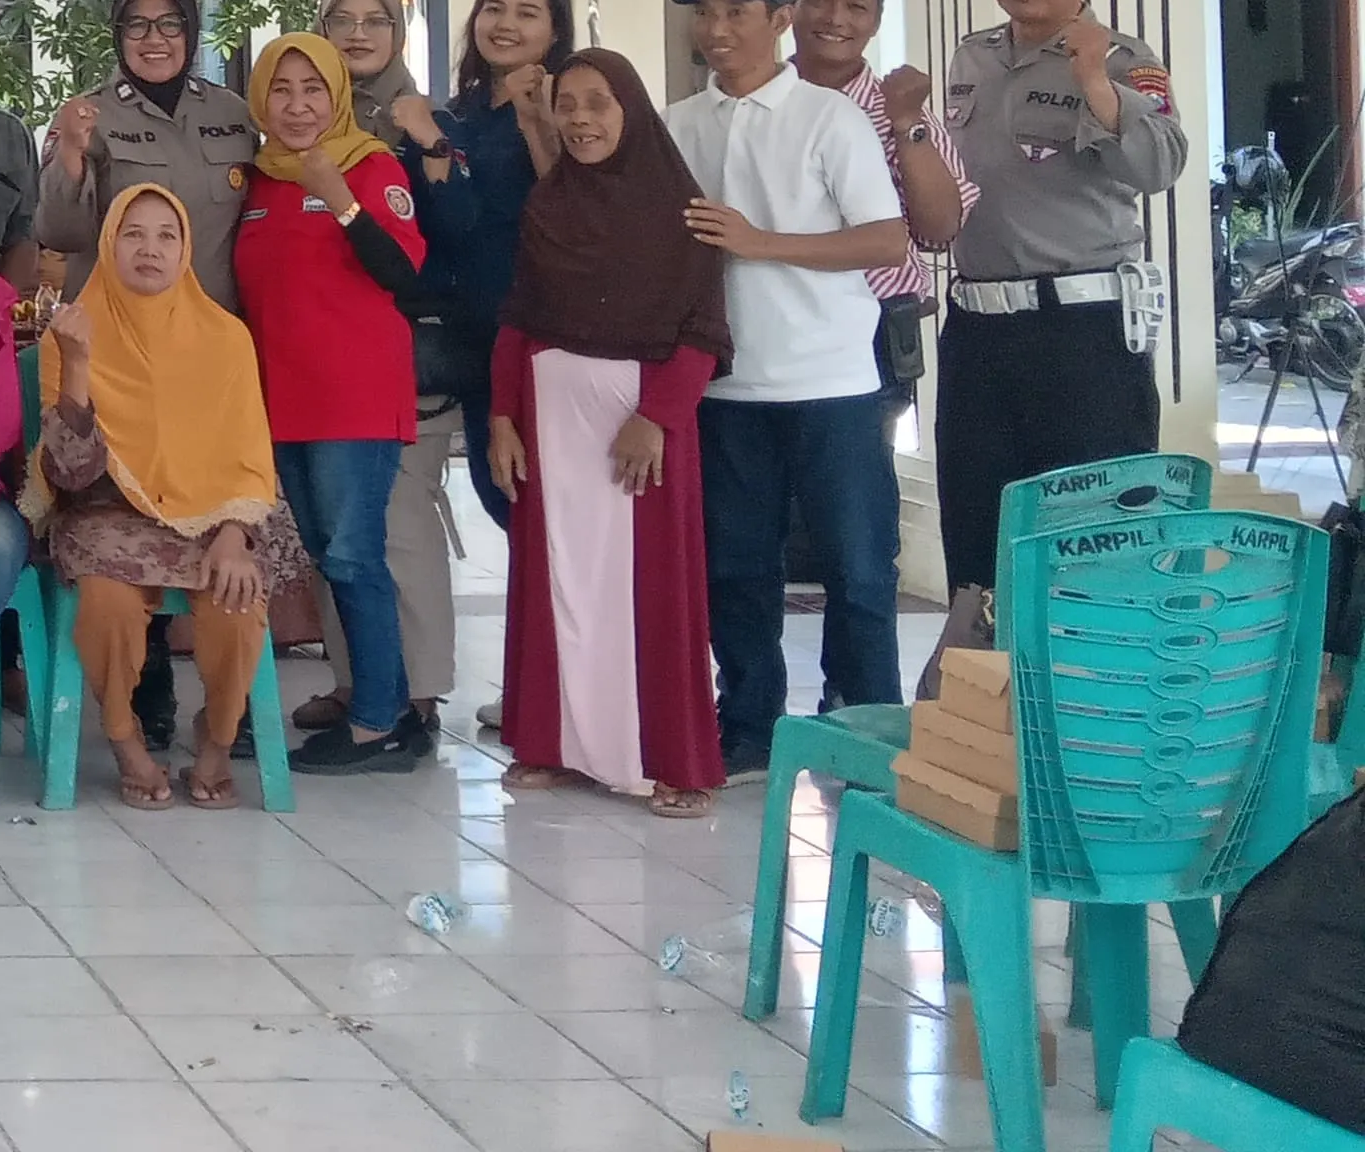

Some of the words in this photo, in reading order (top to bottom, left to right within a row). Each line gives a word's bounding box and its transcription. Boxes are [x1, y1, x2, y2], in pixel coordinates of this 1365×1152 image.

[1027, 90, 1082, 110] POLRI
[198, 123, 246, 138] POLRI
[1040, 469, 1113, 498] KARPIL
[1056, 529, 1154, 557] KARPIL
[1231, 525, 1290, 553] KARPIL
